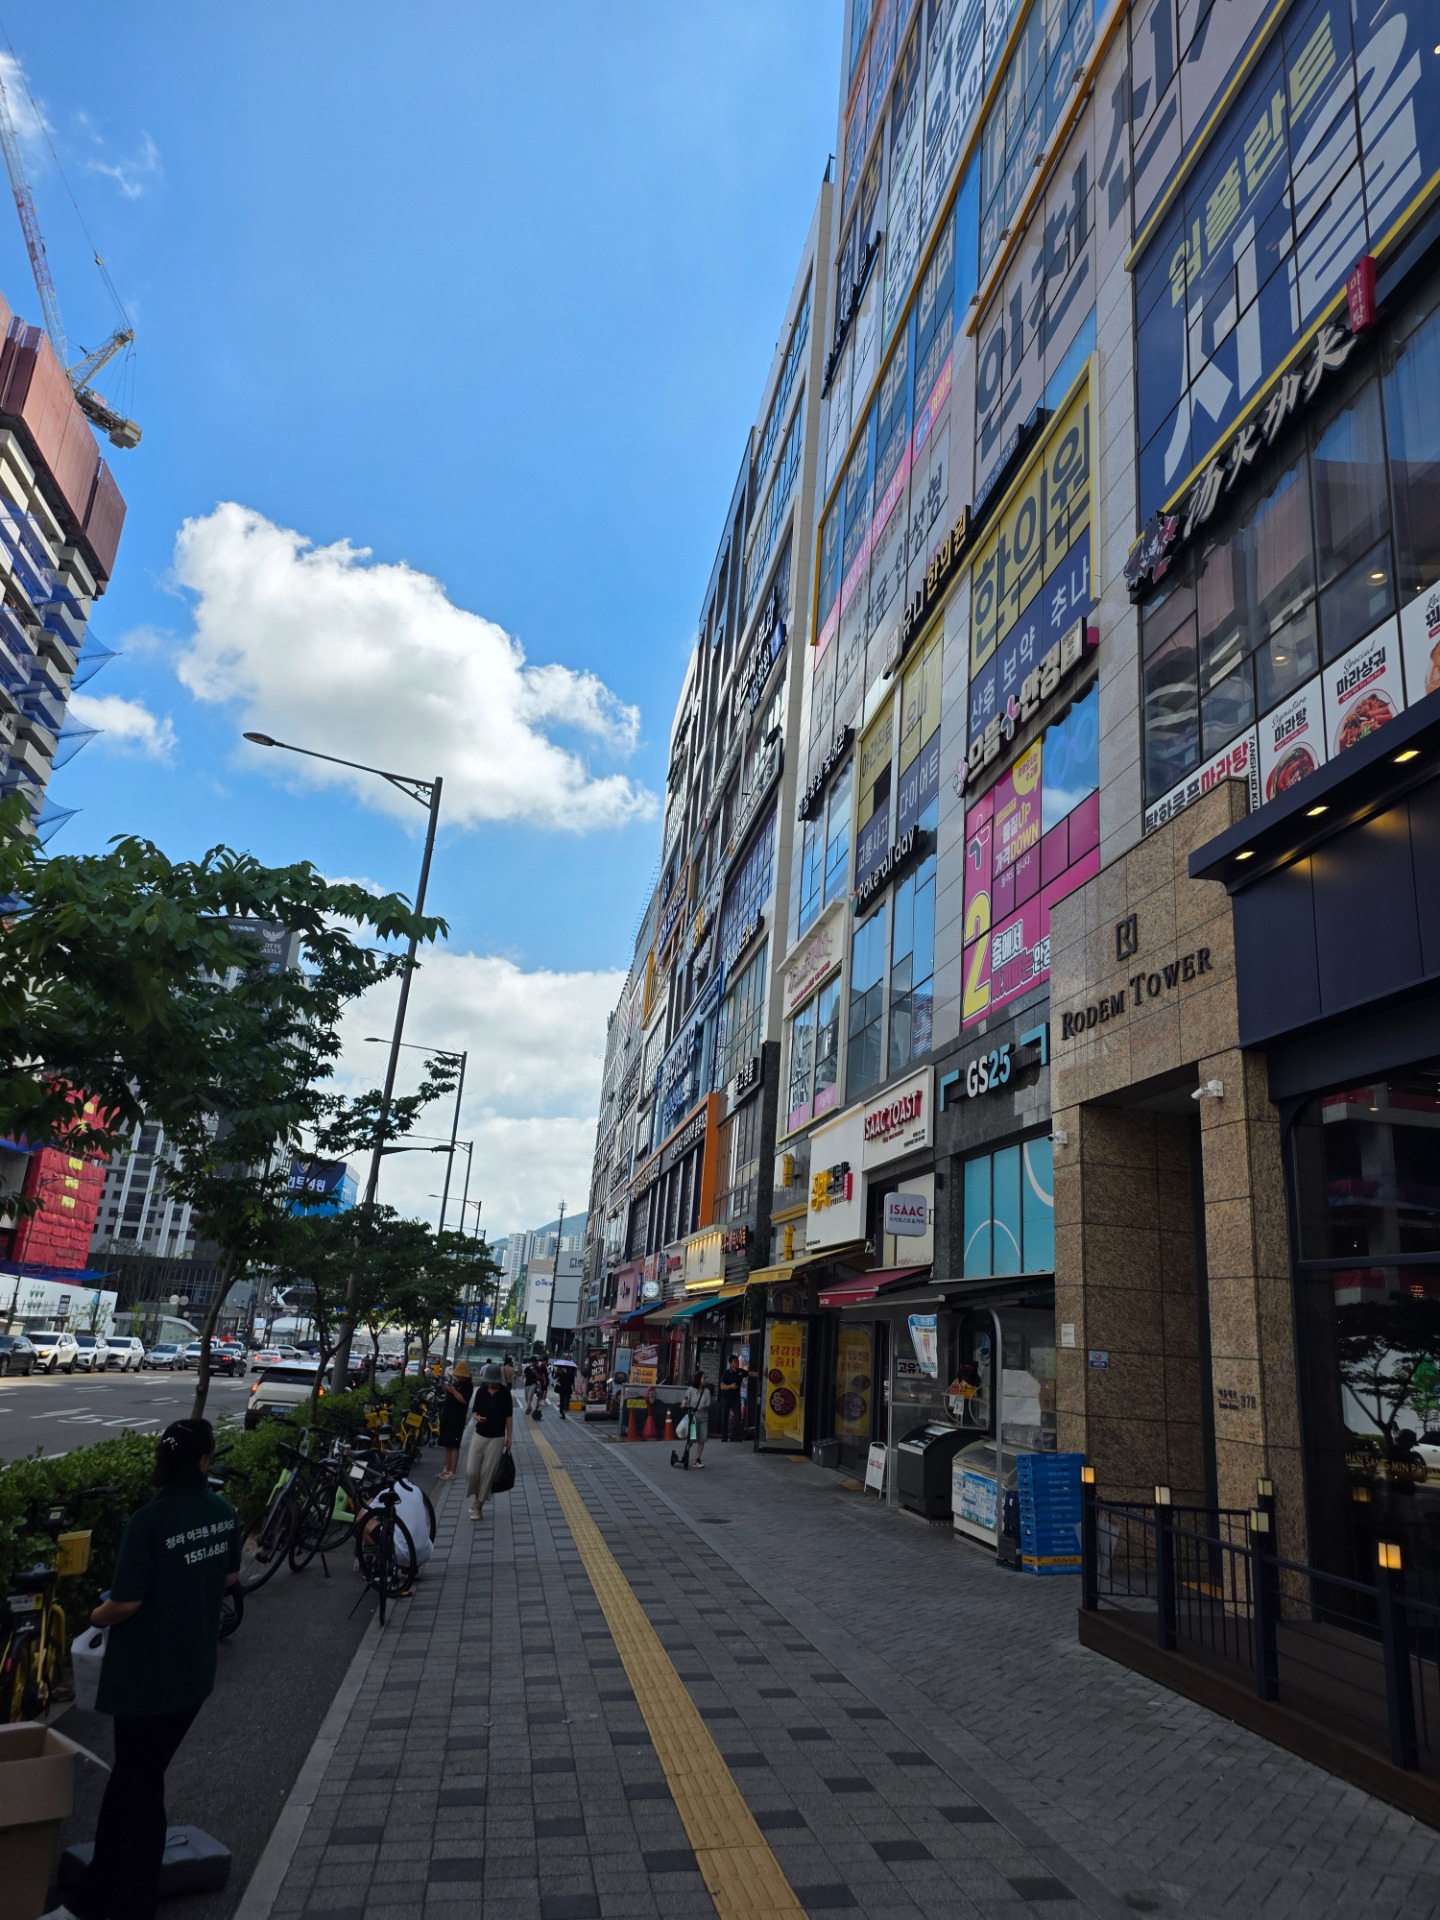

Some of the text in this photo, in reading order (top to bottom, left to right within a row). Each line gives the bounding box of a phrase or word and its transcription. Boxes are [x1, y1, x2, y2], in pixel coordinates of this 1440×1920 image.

[1168, 0, 1336, 316] 임플란트
[1164, 13, 1422, 486] 서울
[1350, 272, 1367, 328] 마라탕
[845, 417, 870, 507] 건강
[878, 320, 910, 430] 검진
[918, 209, 955, 335] 센터
[914, 302, 954, 414] 초음파
[975, 425, 1090, 660] 한의원
[903, 512, 968, 639] 유니 한의원
[970, 683, 996, 734] 산후
[1003, 624, 1036, 693] 보약
[1049, 554, 1090, 632] 추나
[1336, 646, 1387, 698] 마라샹궈
[905, 675, 928, 743] 유니
[967, 646, 1062, 784] 으뜸 안경
[1274, 707, 1308, 744] 마라탕
[861, 703, 894, 785] 야간진료
[1201, 740, 1250, 794] 마라탕
[1249, 734, 1258, 791] TANGHUO
[856, 742, 939, 877] 교통사고 다이어트
[859, 862, 880, 905] Poke
[894, 824, 915, 862] day
[1129, 947, 1214, 1006] TOWER
[967, 1043, 1010, 1097] GS25
[888, 1090, 922, 1131] TOAST
[889, 1203, 925, 1217] ISAAC
[591, 1366, 604, 1376] 버거
[769, 1344, 801, 1358] 닭강정
[775, 1358, 796, 1369] 출시
[1345, 1452, 1363, 1465] HAN
[1392, 1461, 1409, 1473] MIN
[165, 1533, 185, 1550] 청라
